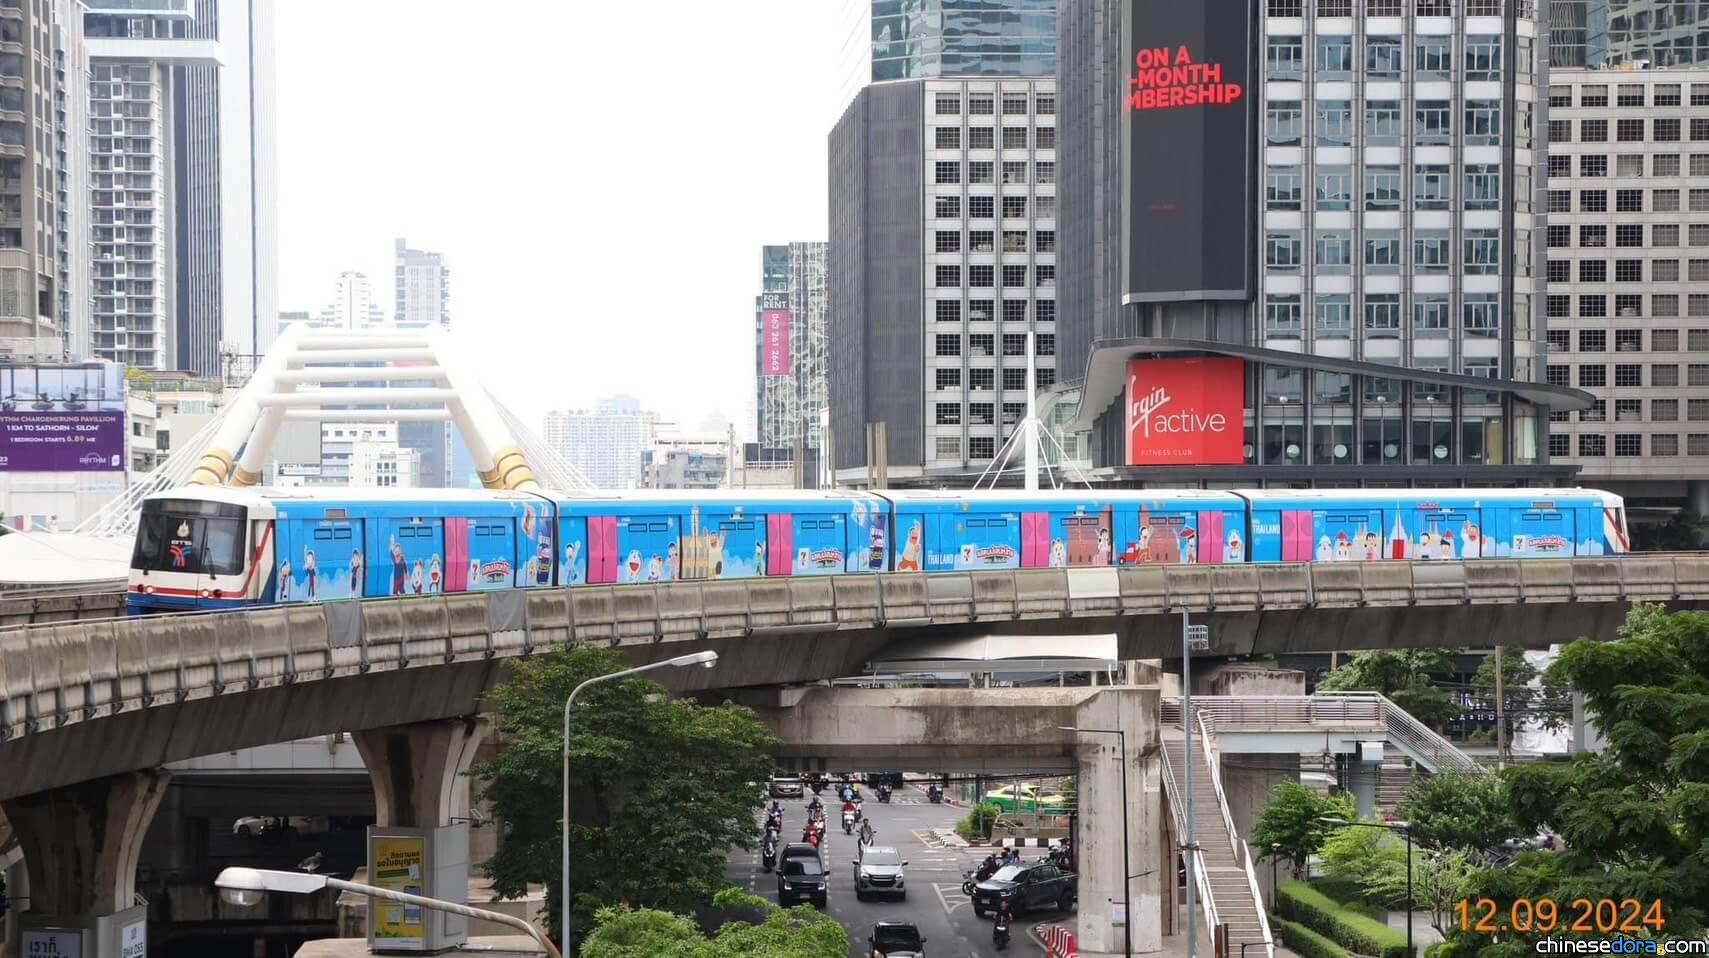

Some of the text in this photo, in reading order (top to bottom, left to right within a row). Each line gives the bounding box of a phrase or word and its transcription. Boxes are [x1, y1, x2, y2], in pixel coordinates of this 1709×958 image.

[1136, 45, 1192, 69] ON A
[763, 301, 787, 309] RENT
[1154, 407, 1226, 433] active
[1141, 448, 1170, 456] FITNESS
